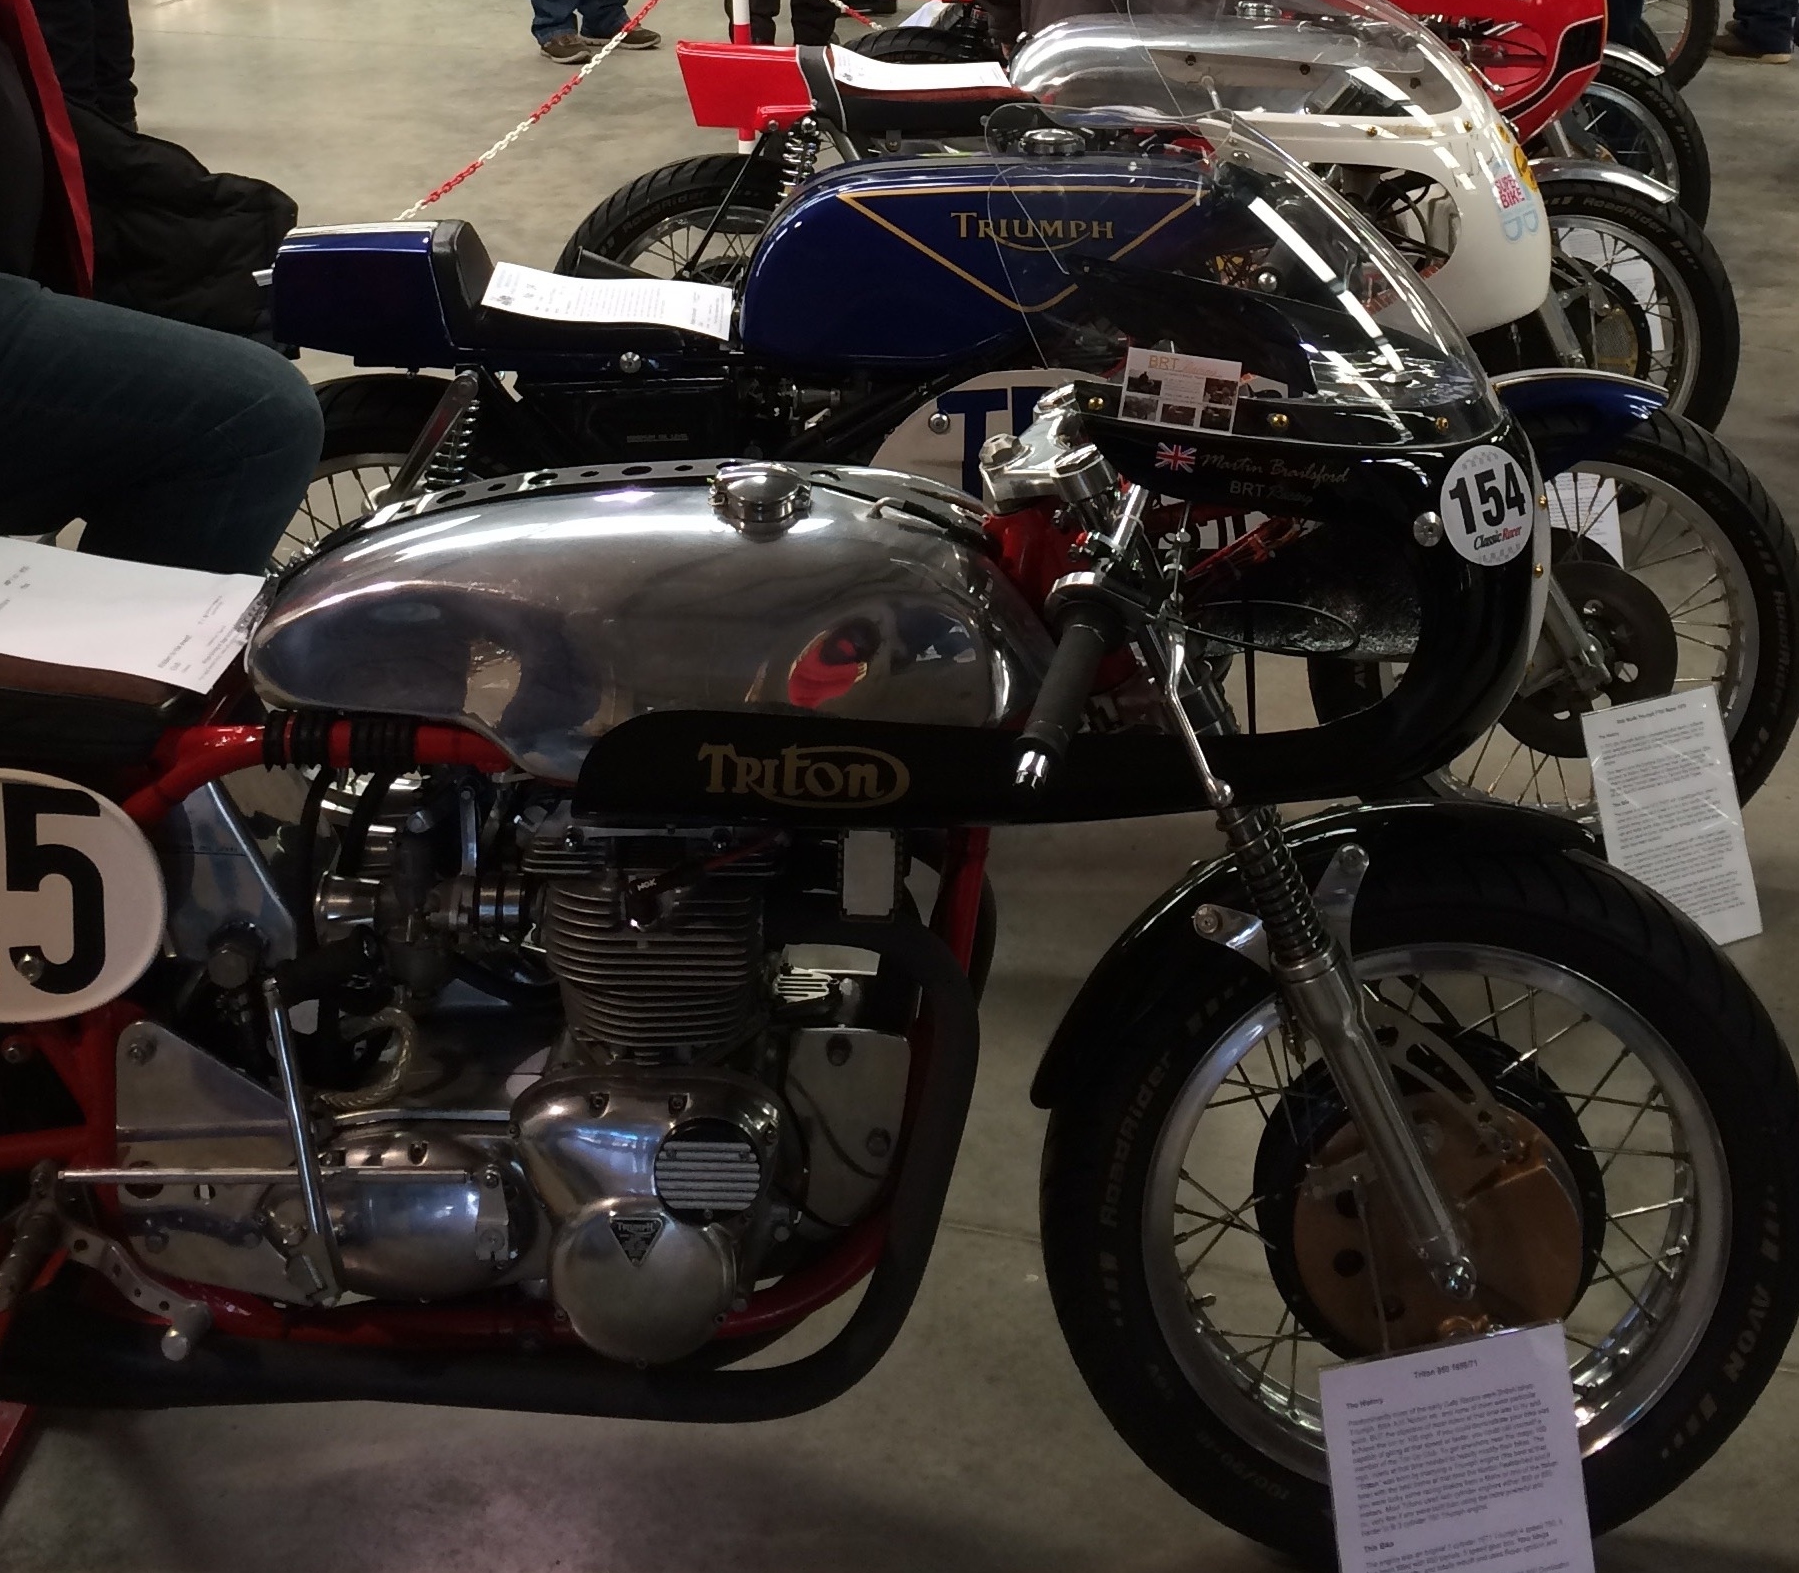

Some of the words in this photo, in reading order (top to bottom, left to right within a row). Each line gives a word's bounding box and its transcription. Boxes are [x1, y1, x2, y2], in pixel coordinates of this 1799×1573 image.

[950, 211, 1115, 243] TRIUMPH
[1148, 354, 1180, 371] BRT
[1201, 453, 1263, 474] Martin
[1229, 479, 1266, 499] BRT
[1448, 462, 1527, 535] 154
[1723, 1282, 1772, 1384] AVON
